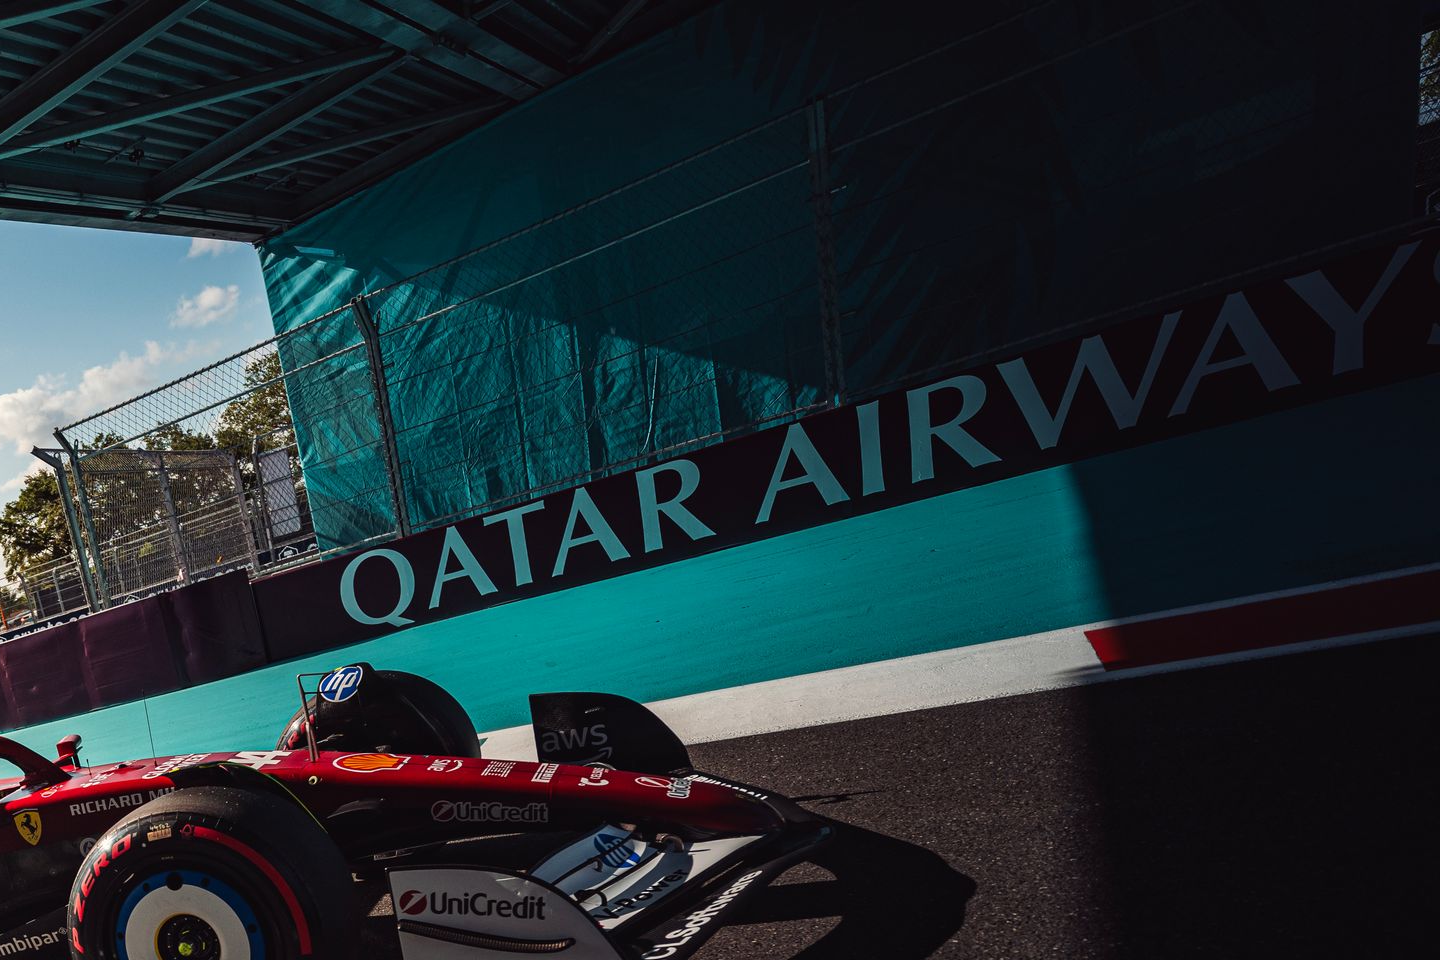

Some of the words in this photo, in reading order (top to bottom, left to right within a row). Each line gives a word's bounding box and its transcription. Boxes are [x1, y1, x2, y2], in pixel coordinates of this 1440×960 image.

[338, 458, 717, 629] QATAR
[755, 240, 1440, 524] AIRWAY
[326, 667, 357, 699] hp
[542, 723, 608, 753] aws
[69, 792, 143, 817] RICHARD
[455, 801, 548, 823] UniCredit
[430, 891, 547, 921] UniCredit
